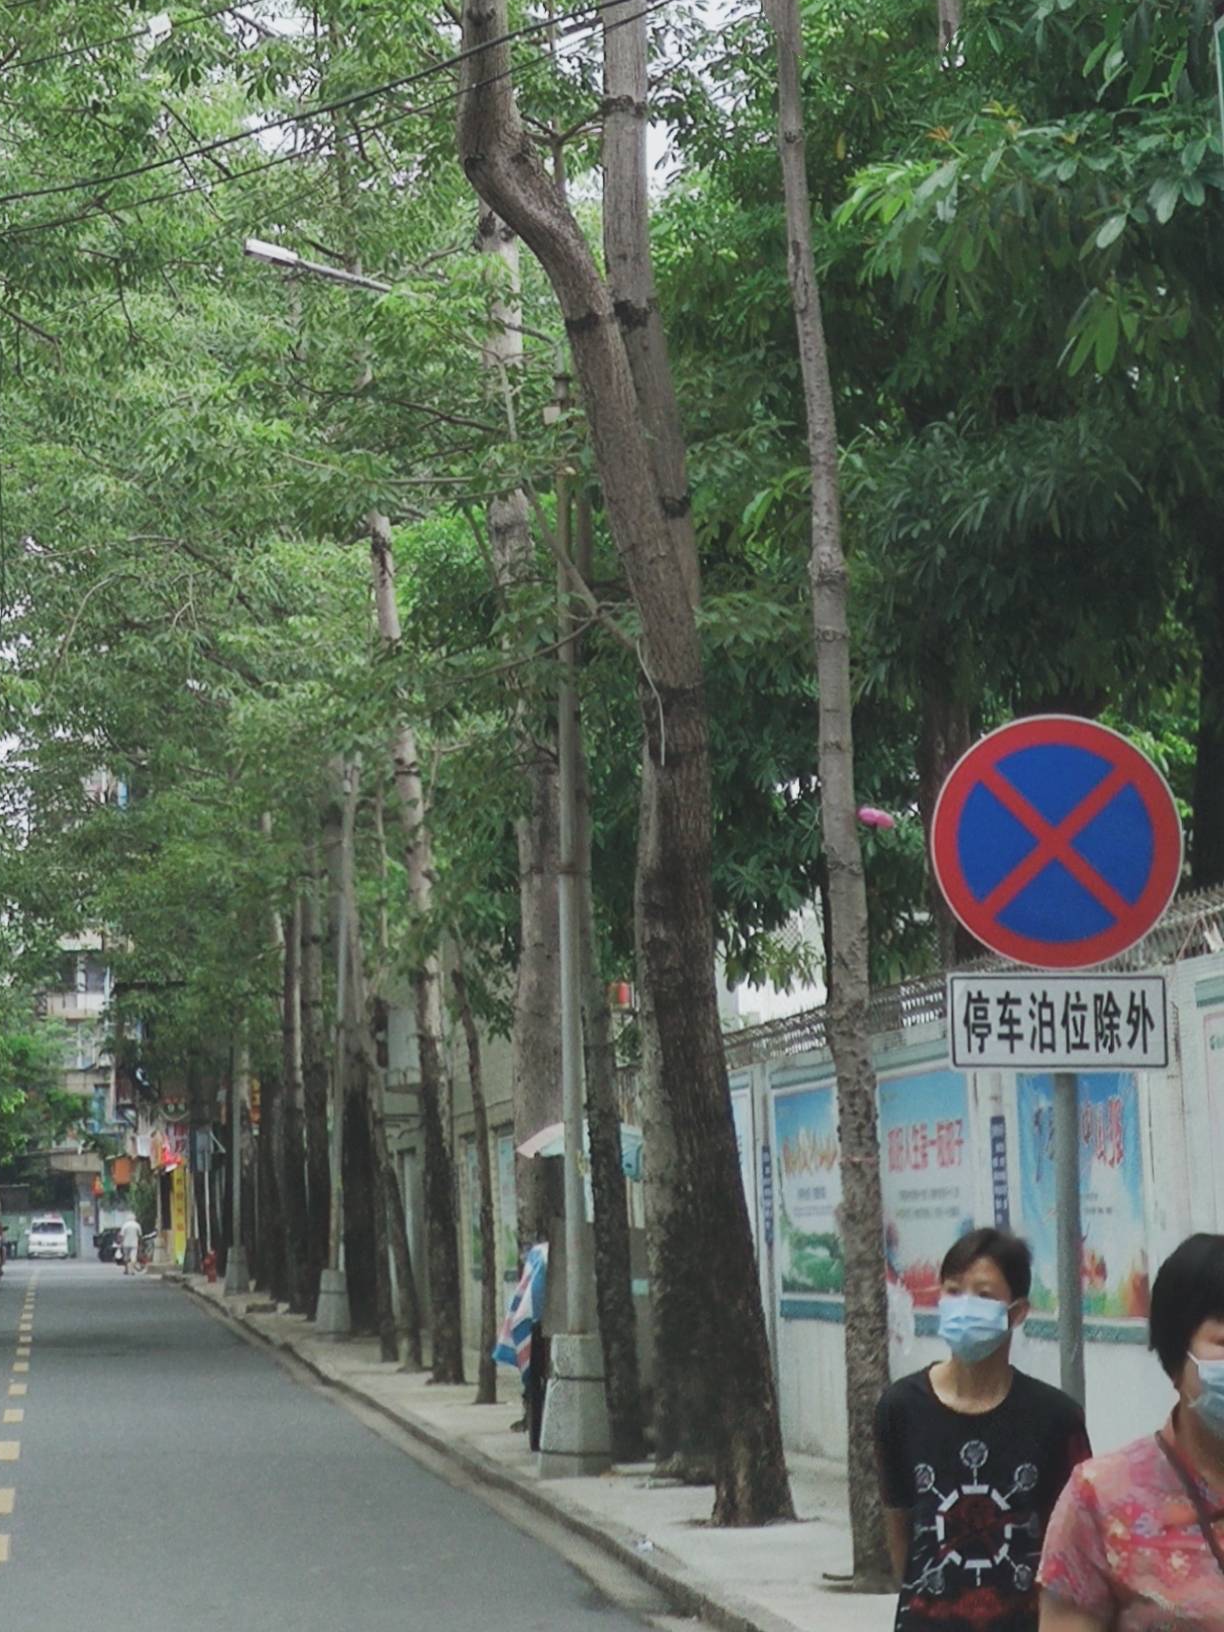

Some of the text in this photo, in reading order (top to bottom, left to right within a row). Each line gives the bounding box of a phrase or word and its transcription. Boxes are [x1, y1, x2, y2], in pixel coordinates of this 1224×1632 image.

[963, 989, 1155, 1054] 停车泊位除外
